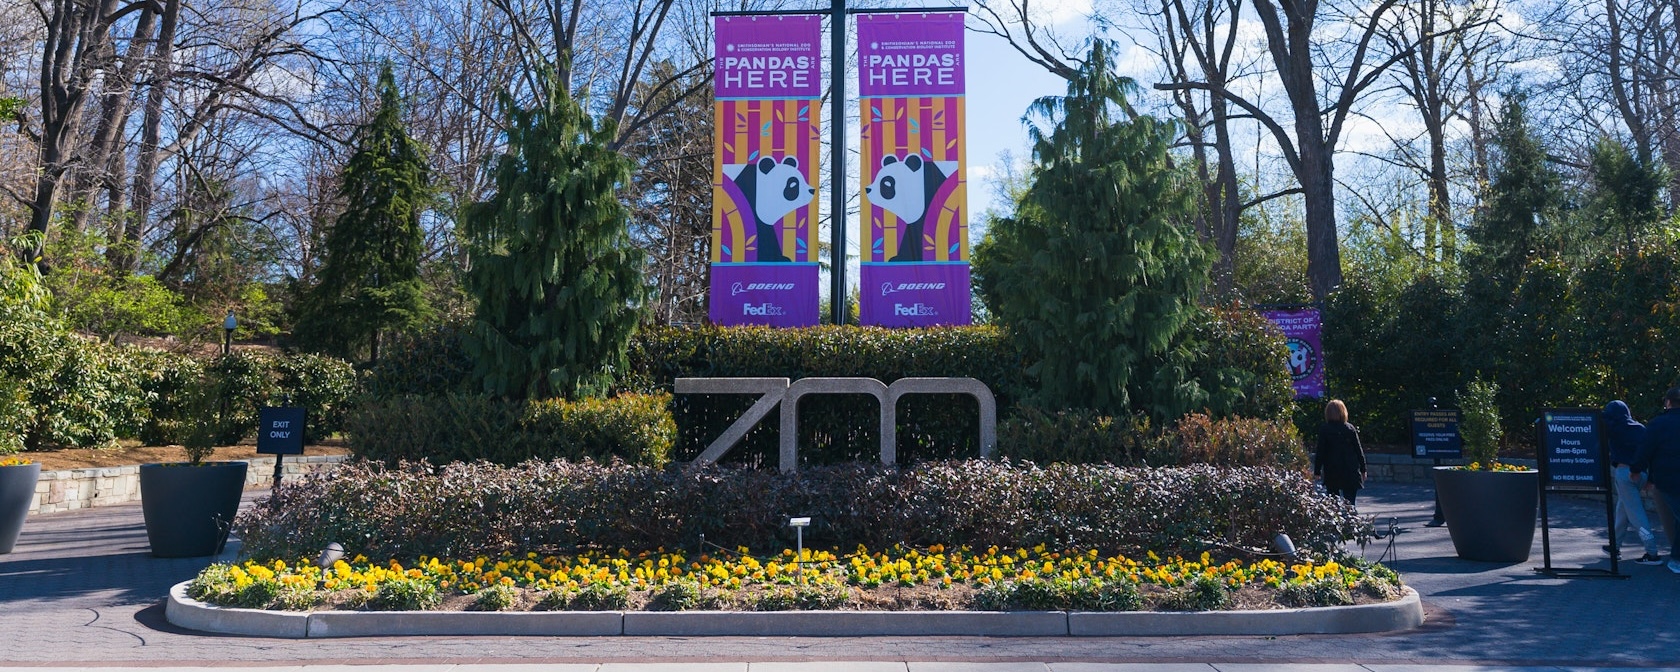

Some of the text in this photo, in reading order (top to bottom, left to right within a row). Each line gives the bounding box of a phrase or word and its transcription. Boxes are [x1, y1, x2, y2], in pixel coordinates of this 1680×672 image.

[725, 56, 810, 70] PANDAS
[869, 54, 954, 67] PANDAS
[724, 70, 810, 88] HERE
[869, 68, 955, 86] HERE
[743, 302, 782, 316] FedEx
[894, 303, 934, 316] FedEx
[1548, 424, 1591, 432] Welcome!
